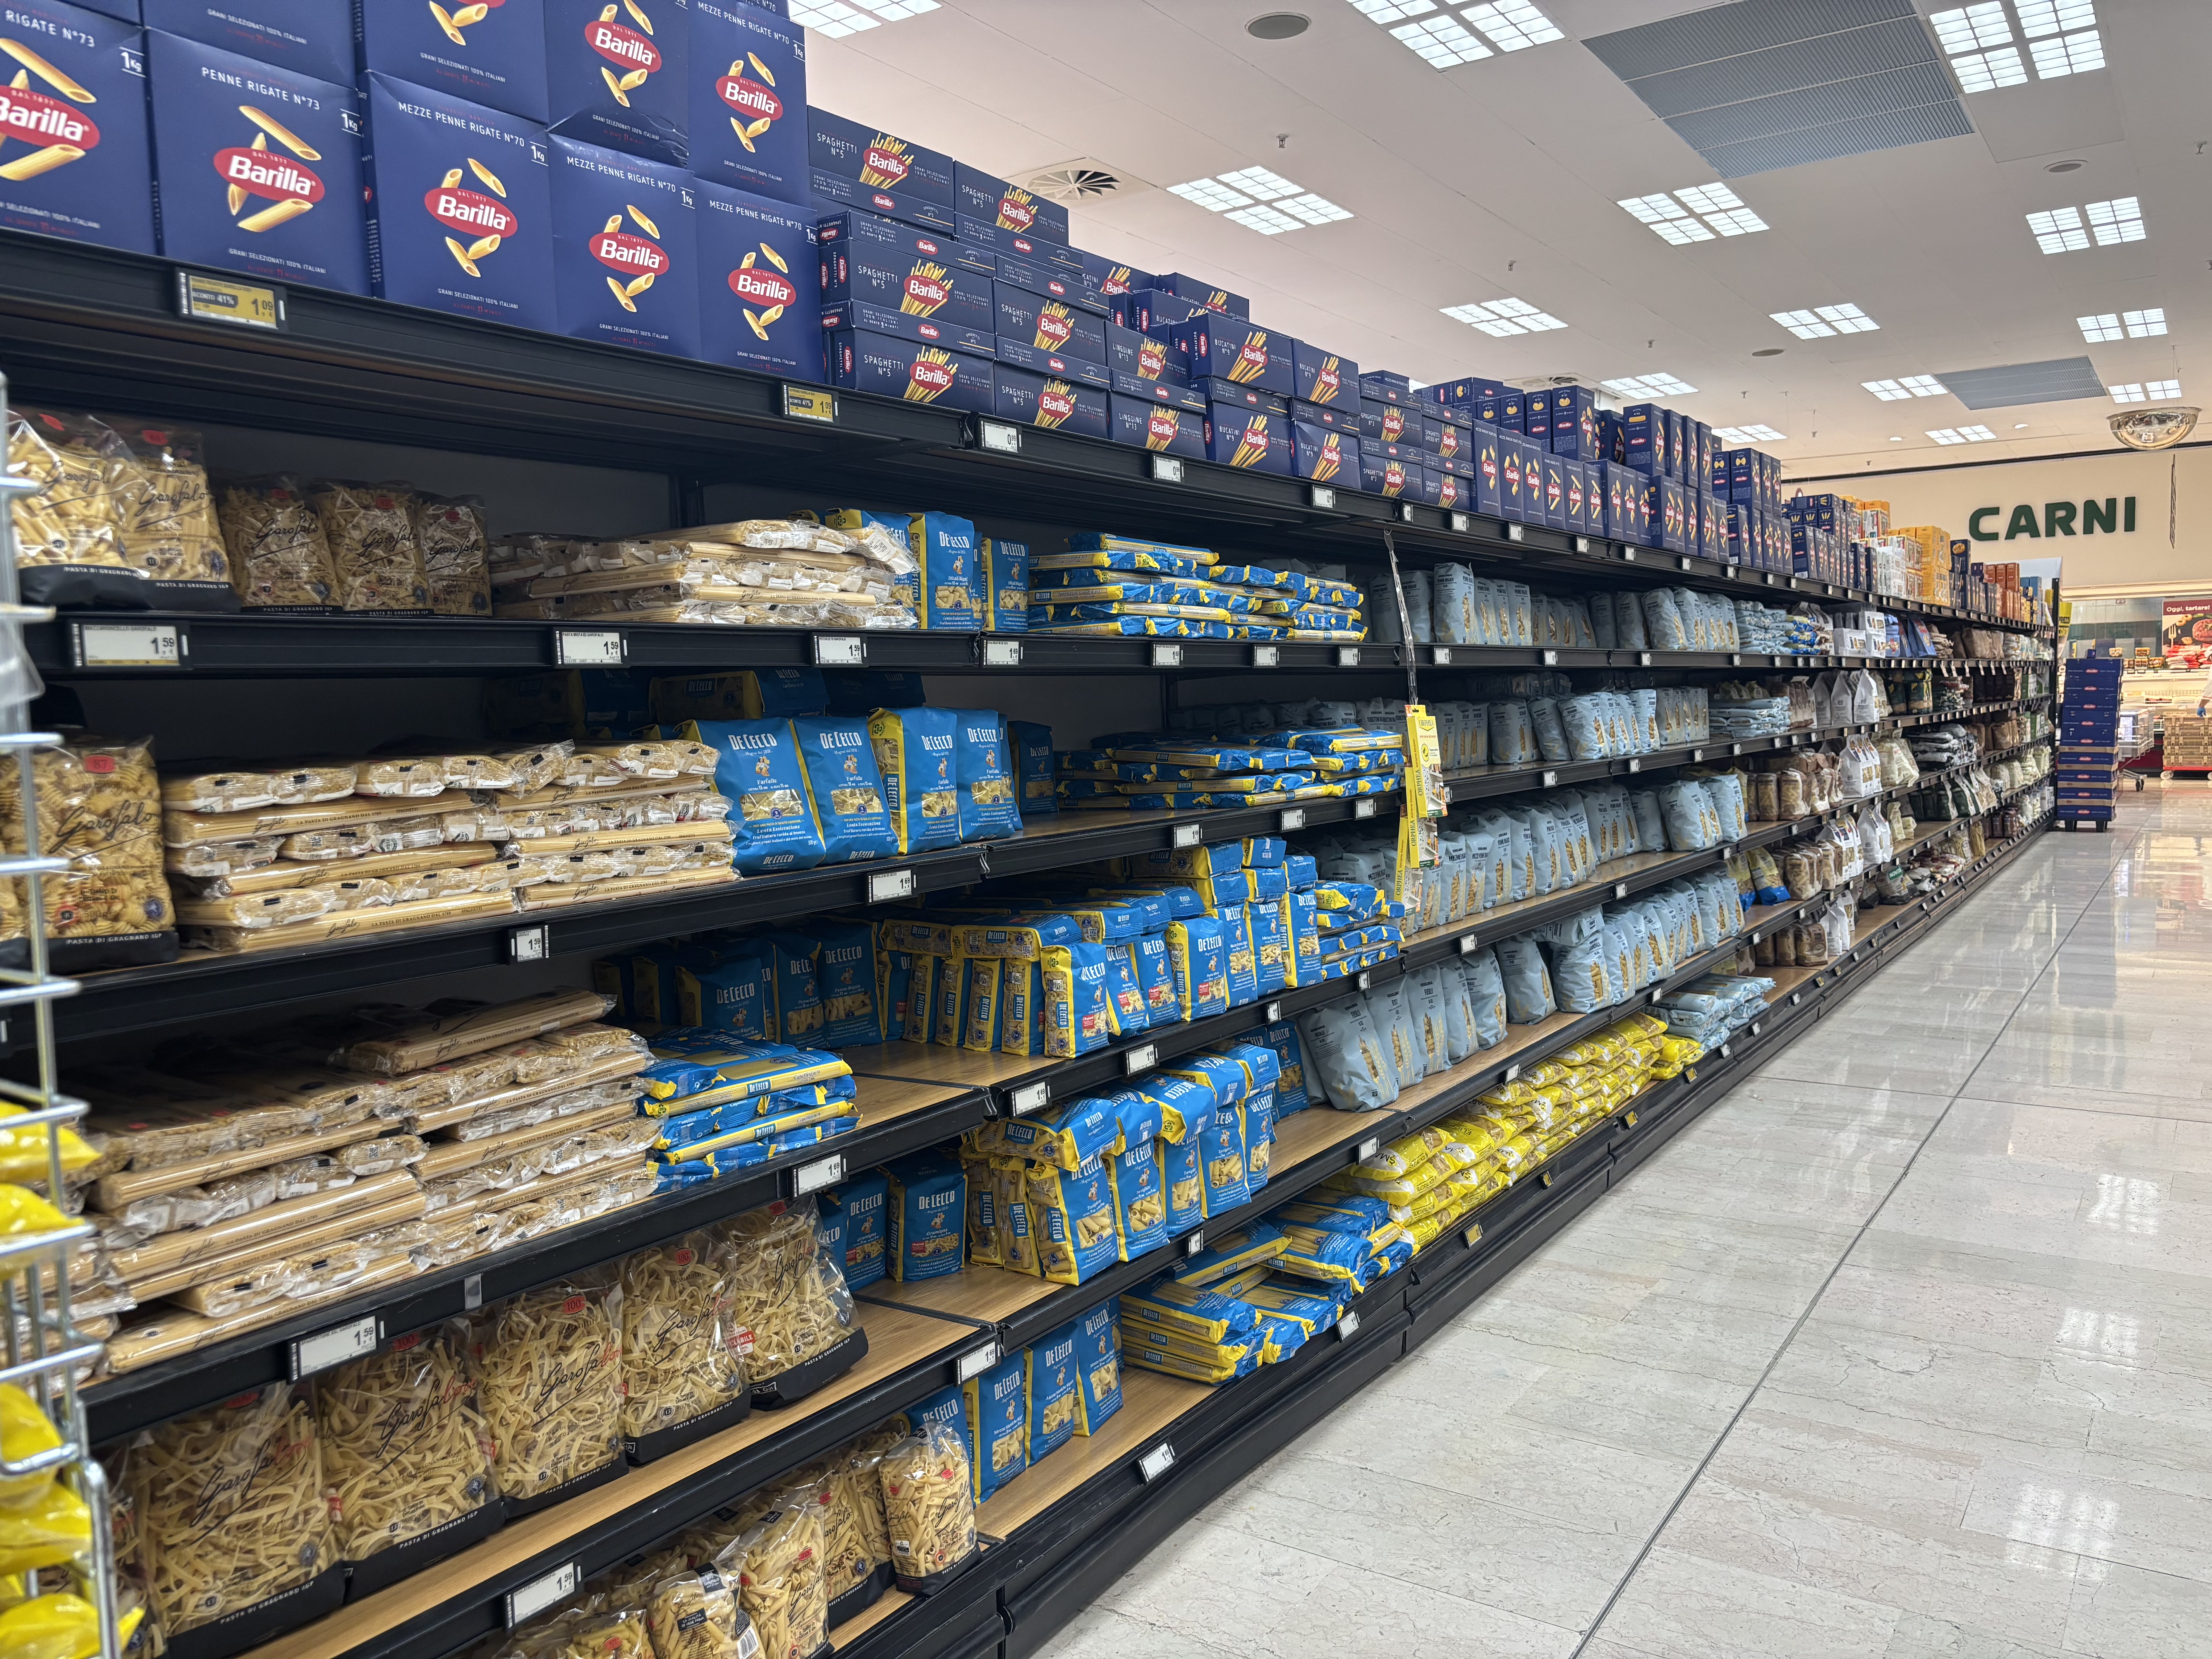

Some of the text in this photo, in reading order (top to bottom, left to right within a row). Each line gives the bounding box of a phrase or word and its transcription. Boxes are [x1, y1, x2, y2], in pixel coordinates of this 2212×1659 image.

[5, 10, 95, 48] RIGATE N°73
[698, 2, 789, 45] MEZZE PENNE RIGATE N°70
[596, 27, 653, 66] Barilla
[201, 67, 320, 110] PENNE RIGATE N°73
[725, 81, 775, 115] Barilla
[0, 96, 84, 142] Barilla
[399, 101, 525, 147] MEZZE PENNE RIGATE N°70
[531, 145, 544, 162] 1Kg
[817, 132, 857, 155] SPAGHETTI
[831, 147, 844, 158] N°5
[869, 152, 904, 176] Barilla
[229, 155, 311, 196] Barilla
[567, 156, 676, 193] MEZZE PENNE RIGATE N°70
[472, 194, 487, 203] 1877
[682, 190, 692, 205] 1Kg
[962, 184, 994, 204] SPAGHETTI
[973, 197, 983, 208] N°5
[438, 195, 507, 231] Barilla
[710, 200, 802, 230] MEZZE PENNE RIGATE N°70
[1002, 202, 1031, 223] Barilla
[229, 248, 247, 258] GRANI
[249, 252, 285, 266] SELEZIONATI
[286, 261, 302, 269] 100%
[303, 264, 326, 274] ITALIANI
[601, 239, 659, 268] Barilla
[737, 273, 787, 301] Barilla
[192, 291, 234, 305] SCONTO 41%
[1001, 304, 1032, 321] SPAGHETTI
[1012, 314, 1023, 325] N°5
[1041, 319, 1068, 336] Barilla
[1214, 338, 1236, 351] BUCATINI
[864, 354, 904, 371] SPAGHETTI
[1244, 348, 1265, 364] Barilla
[878, 366, 891, 377] N°5
[915, 367, 950, 385] Barilla
[1002, 385, 1034, 400] SPAGHETTI
[1013, 395, 1024, 405] N°5
[1042, 396, 1070, 414] Barilla
[1119, 413, 1143, 425] LINGUINE
[1151, 422, 1174, 436] Barilla
[1219, 425, 1240, 436] BUCATINI
[1247, 434, 1266, 446] Barilla
[1482, 462, 1496, 474] Barilla
[1387, 474, 1402, 484] Barilla
[134, 480, 210, 516] Garofalo
[1968, 496, 2136, 541] CARNI
[358, 523, 418, 557] Garofalo
[426, 537, 483, 563] Garofalo
[1415, 769, 1423, 797] ORPHEA
[48, 800, 160, 854] Garofalo
[108, 934, 149, 943] GRAGNANO
[678, 1252, 689, 1262] 100
[805, 1355, 819, 1366] PASTA
[824, 1343, 843, 1357] GRAGNANO
[399, 1537, 421, 1549] PASTA
[432, 1519, 465, 1536] GRAGNANO
[467, 1511, 478, 1519] IGP
